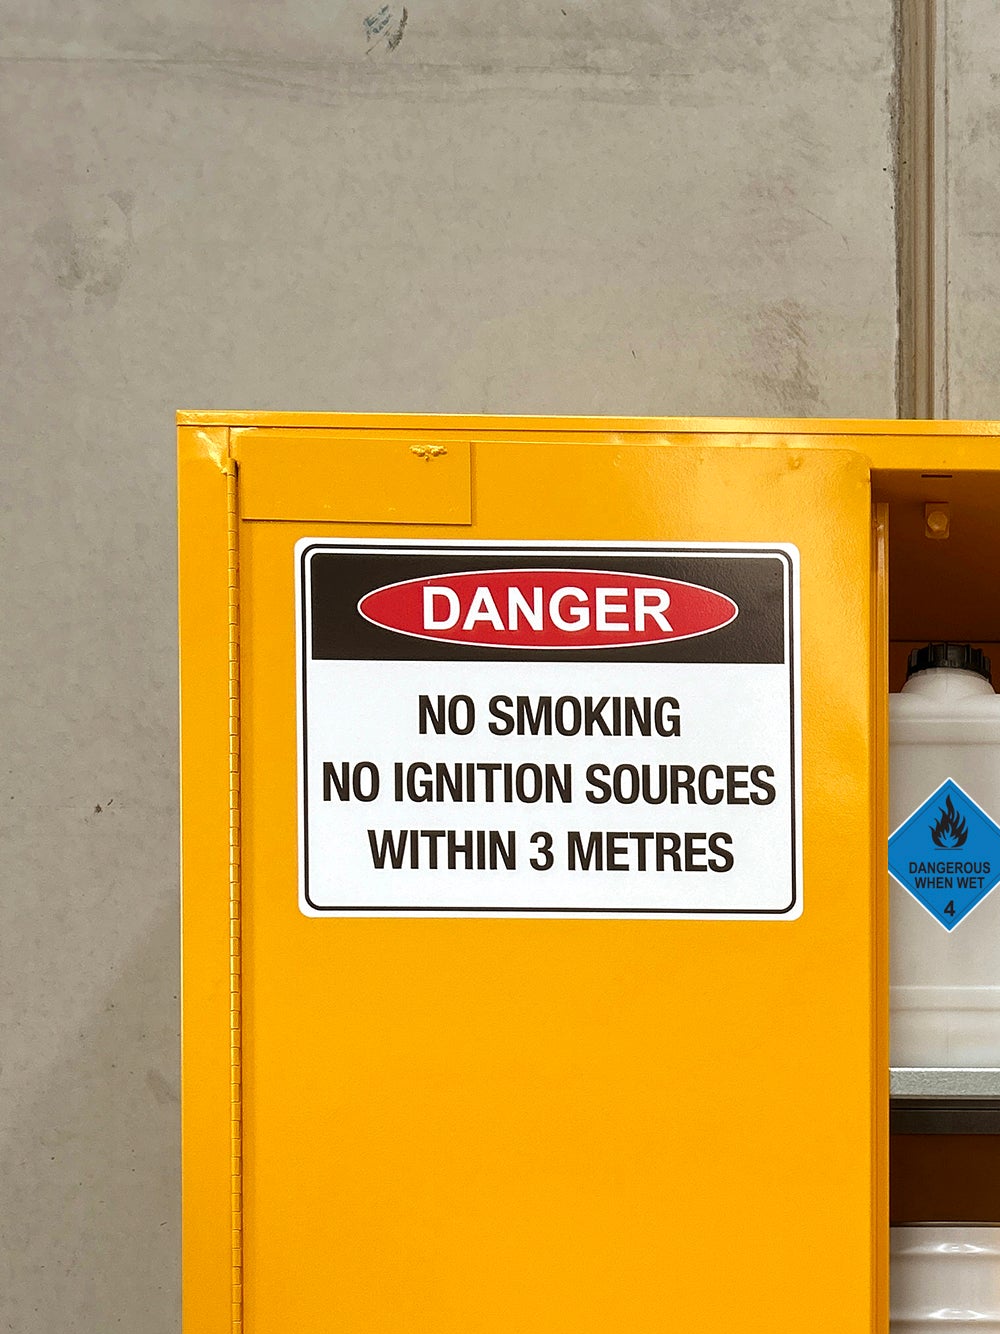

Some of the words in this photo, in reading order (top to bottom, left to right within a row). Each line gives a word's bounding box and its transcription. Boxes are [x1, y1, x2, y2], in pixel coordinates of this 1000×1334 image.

[422, 585, 674, 632] DANGER
[418, 695, 475, 735] NO
[488, 695, 681, 737] SMOKING
[322, 762, 380, 801] NO
[394, 763, 572, 804] IGNITION
[585, 765, 777, 806] SOURCES
[367, 830, 516, 870] WITHIN
[529, 831, 555, 871] 3
[567, 832, 734, 873] METRES
[909, 862, 990, 874] DANGEROUS
[915, 877, 953, 888] WHEN
[956, 877, 985, 888] WET
[944, 900, 955, 916] 4
